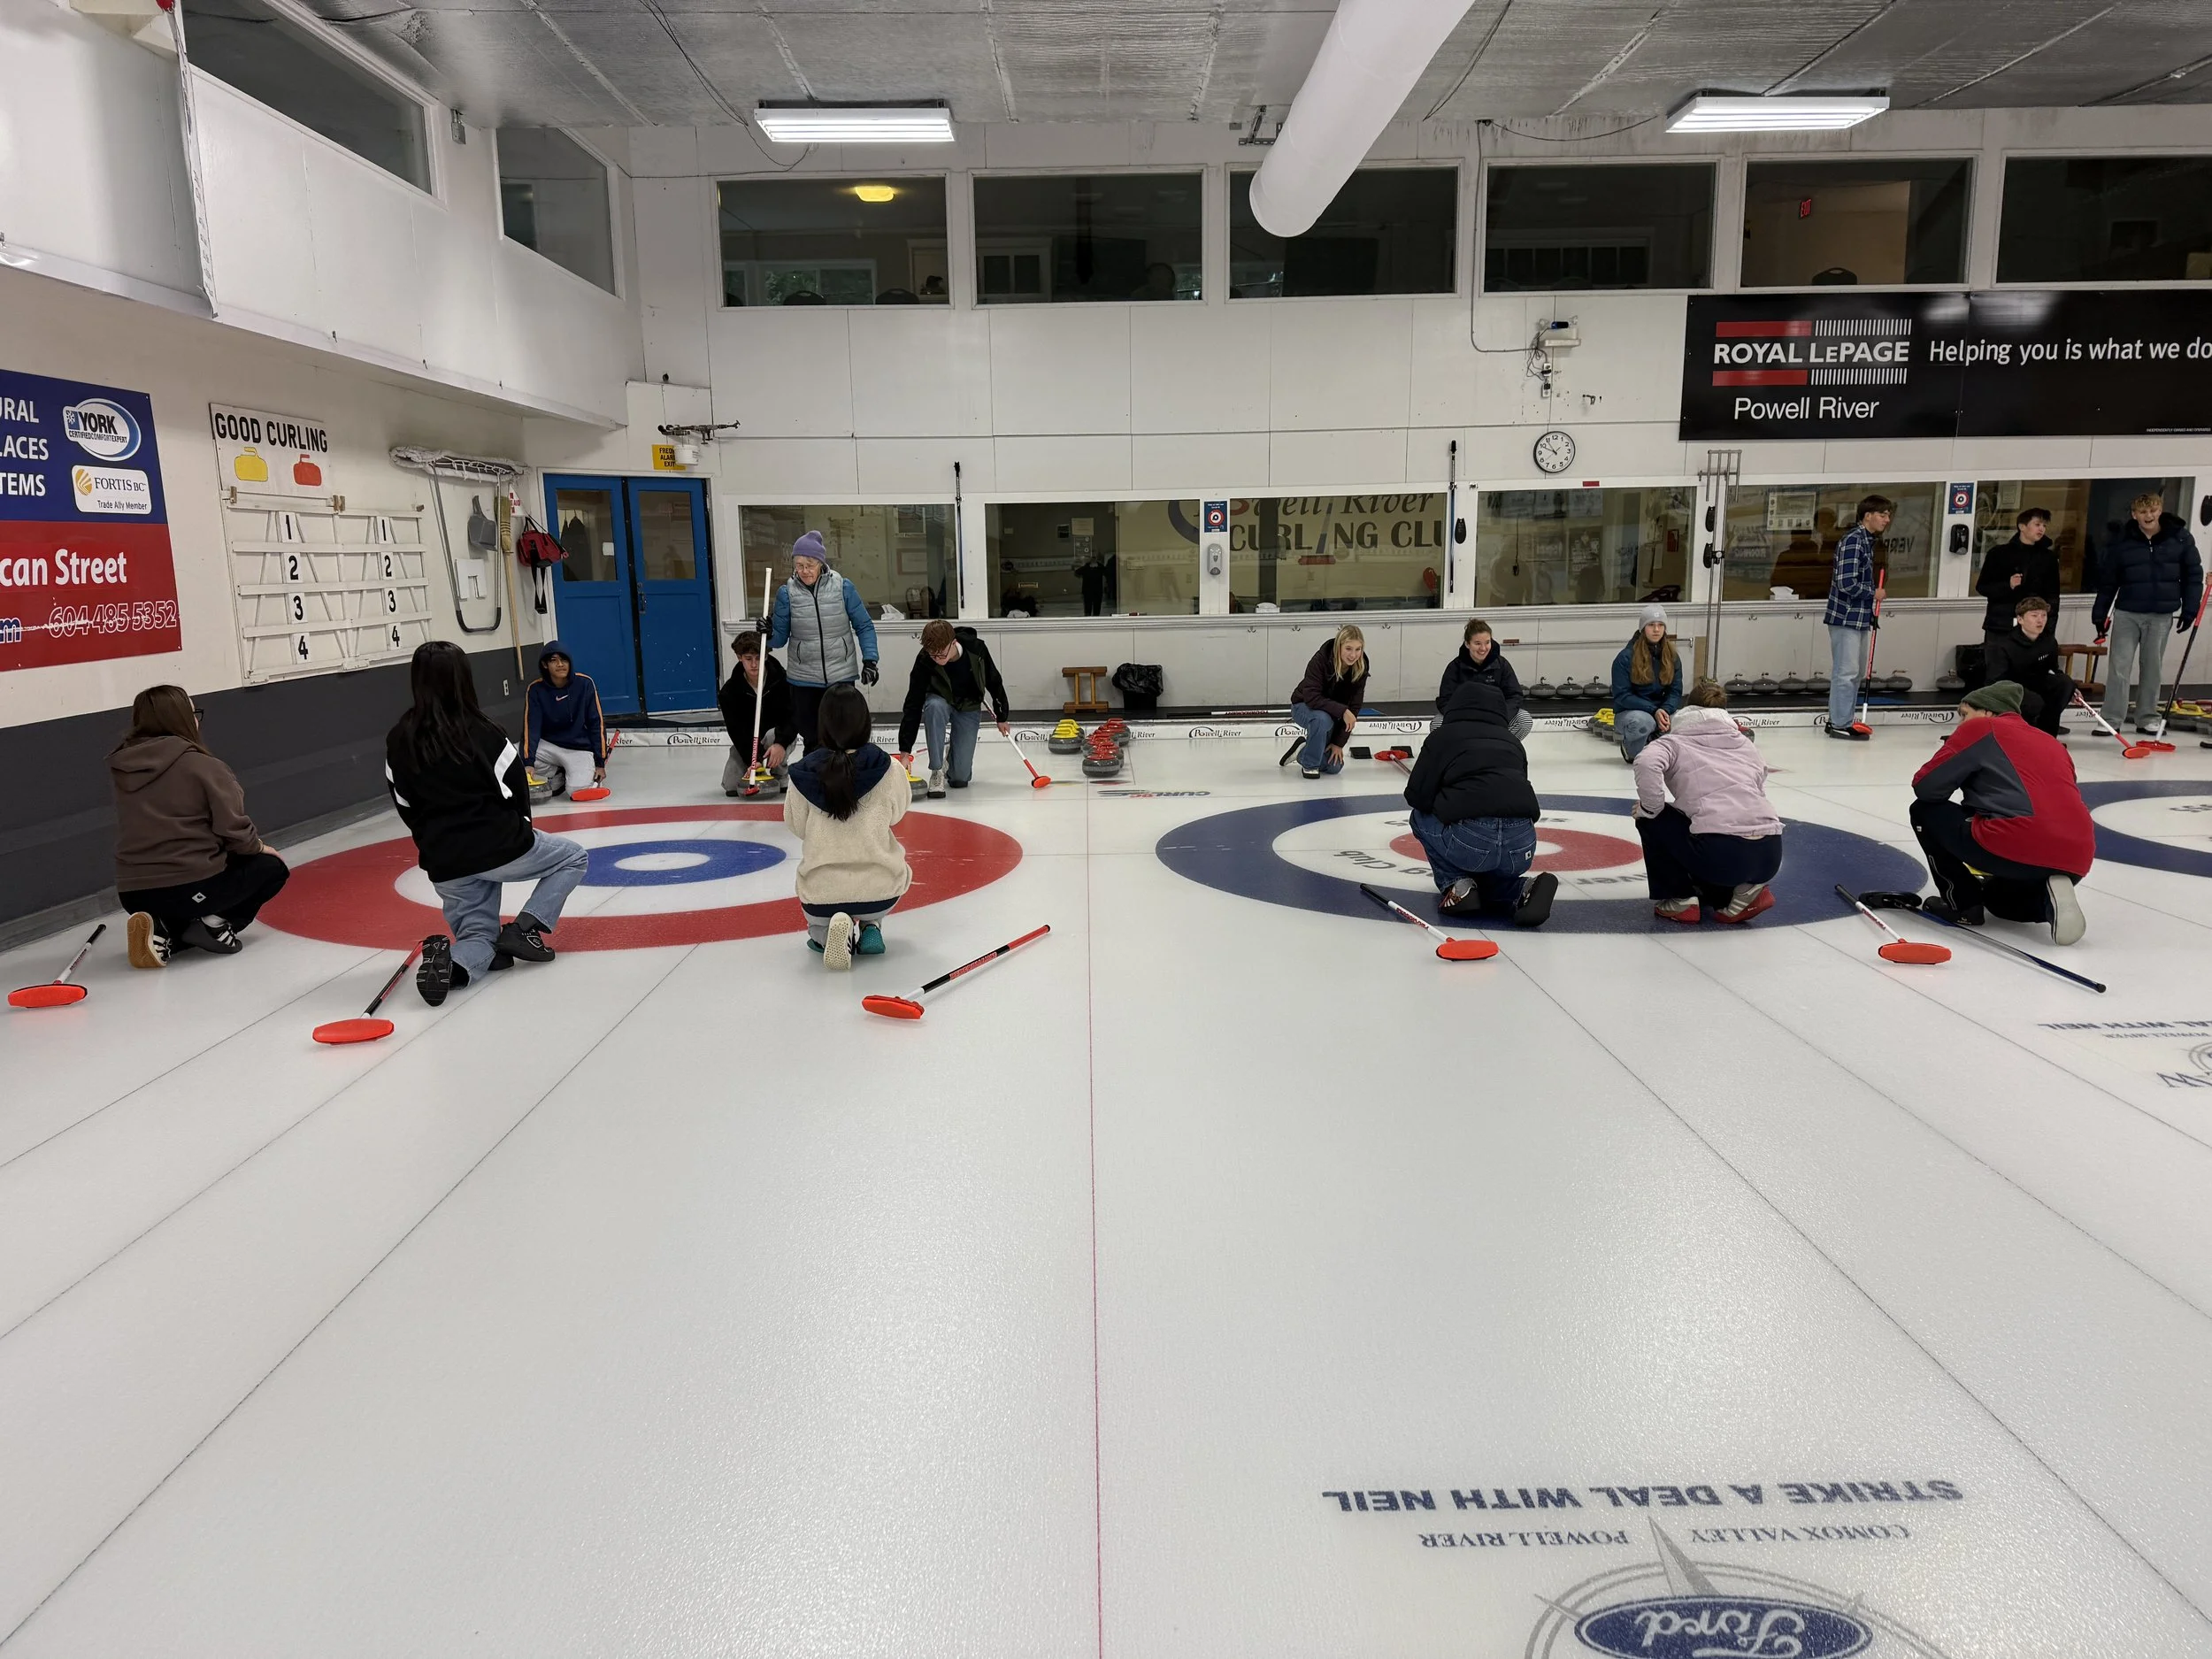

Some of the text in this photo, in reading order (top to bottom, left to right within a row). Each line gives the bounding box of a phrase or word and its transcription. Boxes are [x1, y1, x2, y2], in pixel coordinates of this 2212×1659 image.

[1714, 342, 1803, 365] ROYAL
[1929, 336, 2212, 366] Helping you is what we do
[1733, 396, 1880, 420] Powell River
[78, 411, 118, 434] YORK
[215, 412, 327, 452] GOOD CURLING
[94, 477, 132, 491] FORTIS
[97, 500, 147, 511] Trade Ally Member
[285, 514, 292, 540] 1
[382, 518, 387, 541] 1
[0, 549, 127, 587] can Street
[288, 555, 299, 580] 2
[384, 555, 392, 577] 2
[293, 595, 303, 620] 3
[388, 590, 396, 612] 3
[49, 605, 88, 638] 604
[92, 603, 129, 634] 485
[132, 600, 177, 631] 5352
[297, 635, 309, 660] 4
[391, 626, 400, 647] 4
[1390, 722, 1417, 731] Powell
[1922, 712, 1948, 721] Powell
[672, 735, 698, 744] Powell
[1194, 728, 1219, 737] Powell
[1333, 849, 1397, 870] Club
[1321, 1478, 1964, 1513] STRIKE A DEAL WITH NEIL
[1417, 1525, 1909, 1548] COMOX VALLEY POWELL RIVER
[1634, 1609, 1805, 1659] Ford
